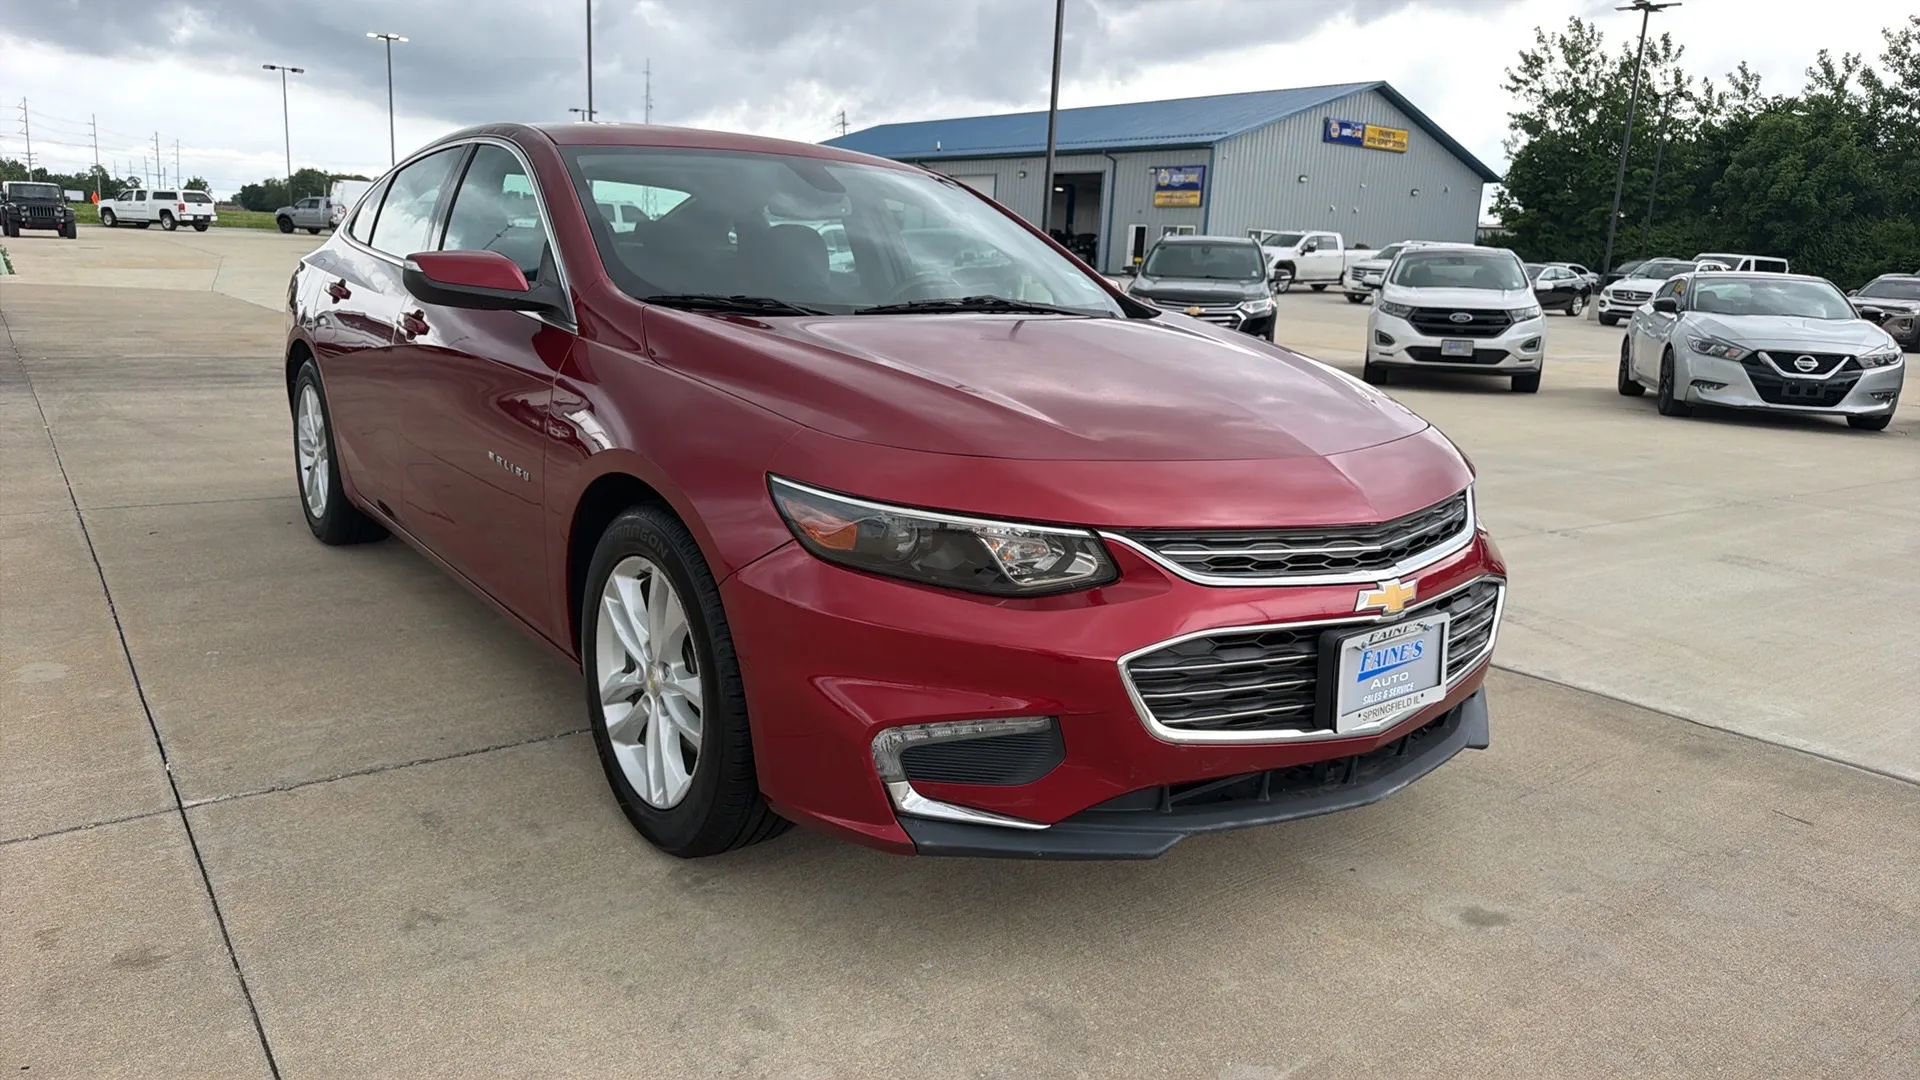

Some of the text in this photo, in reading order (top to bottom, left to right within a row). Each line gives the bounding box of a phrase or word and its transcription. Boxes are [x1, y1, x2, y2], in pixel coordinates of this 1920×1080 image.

[1368, 621, 1425, 643] FAINE'S
[1360, 639, 1424, 672] FAINE'S
[1370, 671, 1409, 690] AUTO
[1362, 682, 1415, 705] SALES & SERVICE
[1362, 697, 1421, 721] SPRINGFIELD IL
